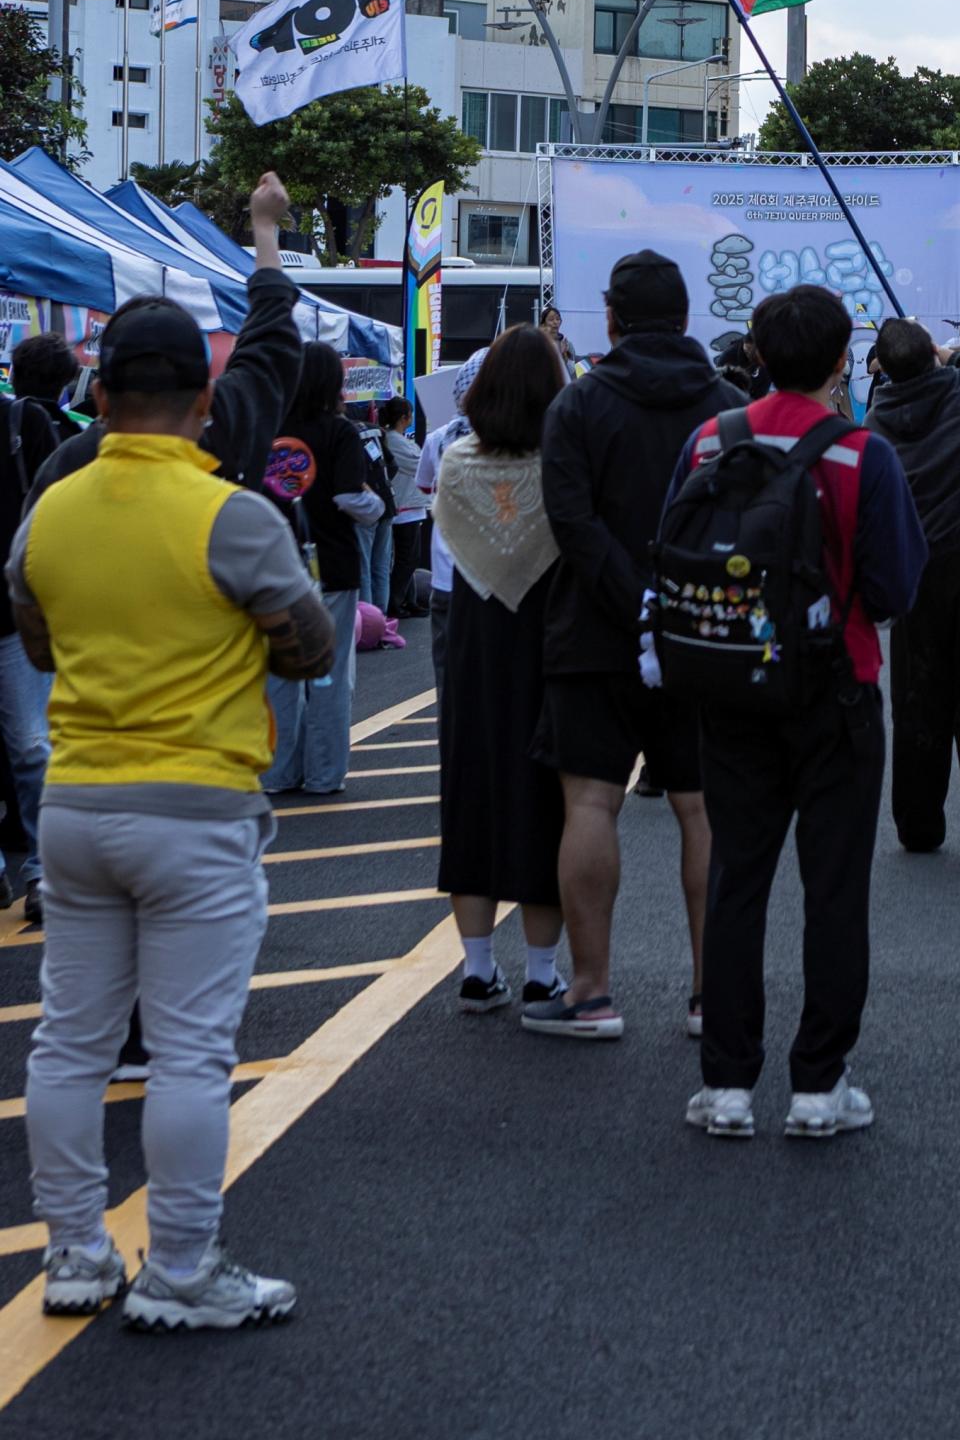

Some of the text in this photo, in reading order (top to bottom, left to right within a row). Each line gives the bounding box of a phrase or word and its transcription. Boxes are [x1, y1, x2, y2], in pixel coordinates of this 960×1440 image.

[713, 194, 744, 205] 2025
[748, 193, 779, 207] 제6회
[746, 212, 846, 222] 6th JEJU QUEER PRIDE
